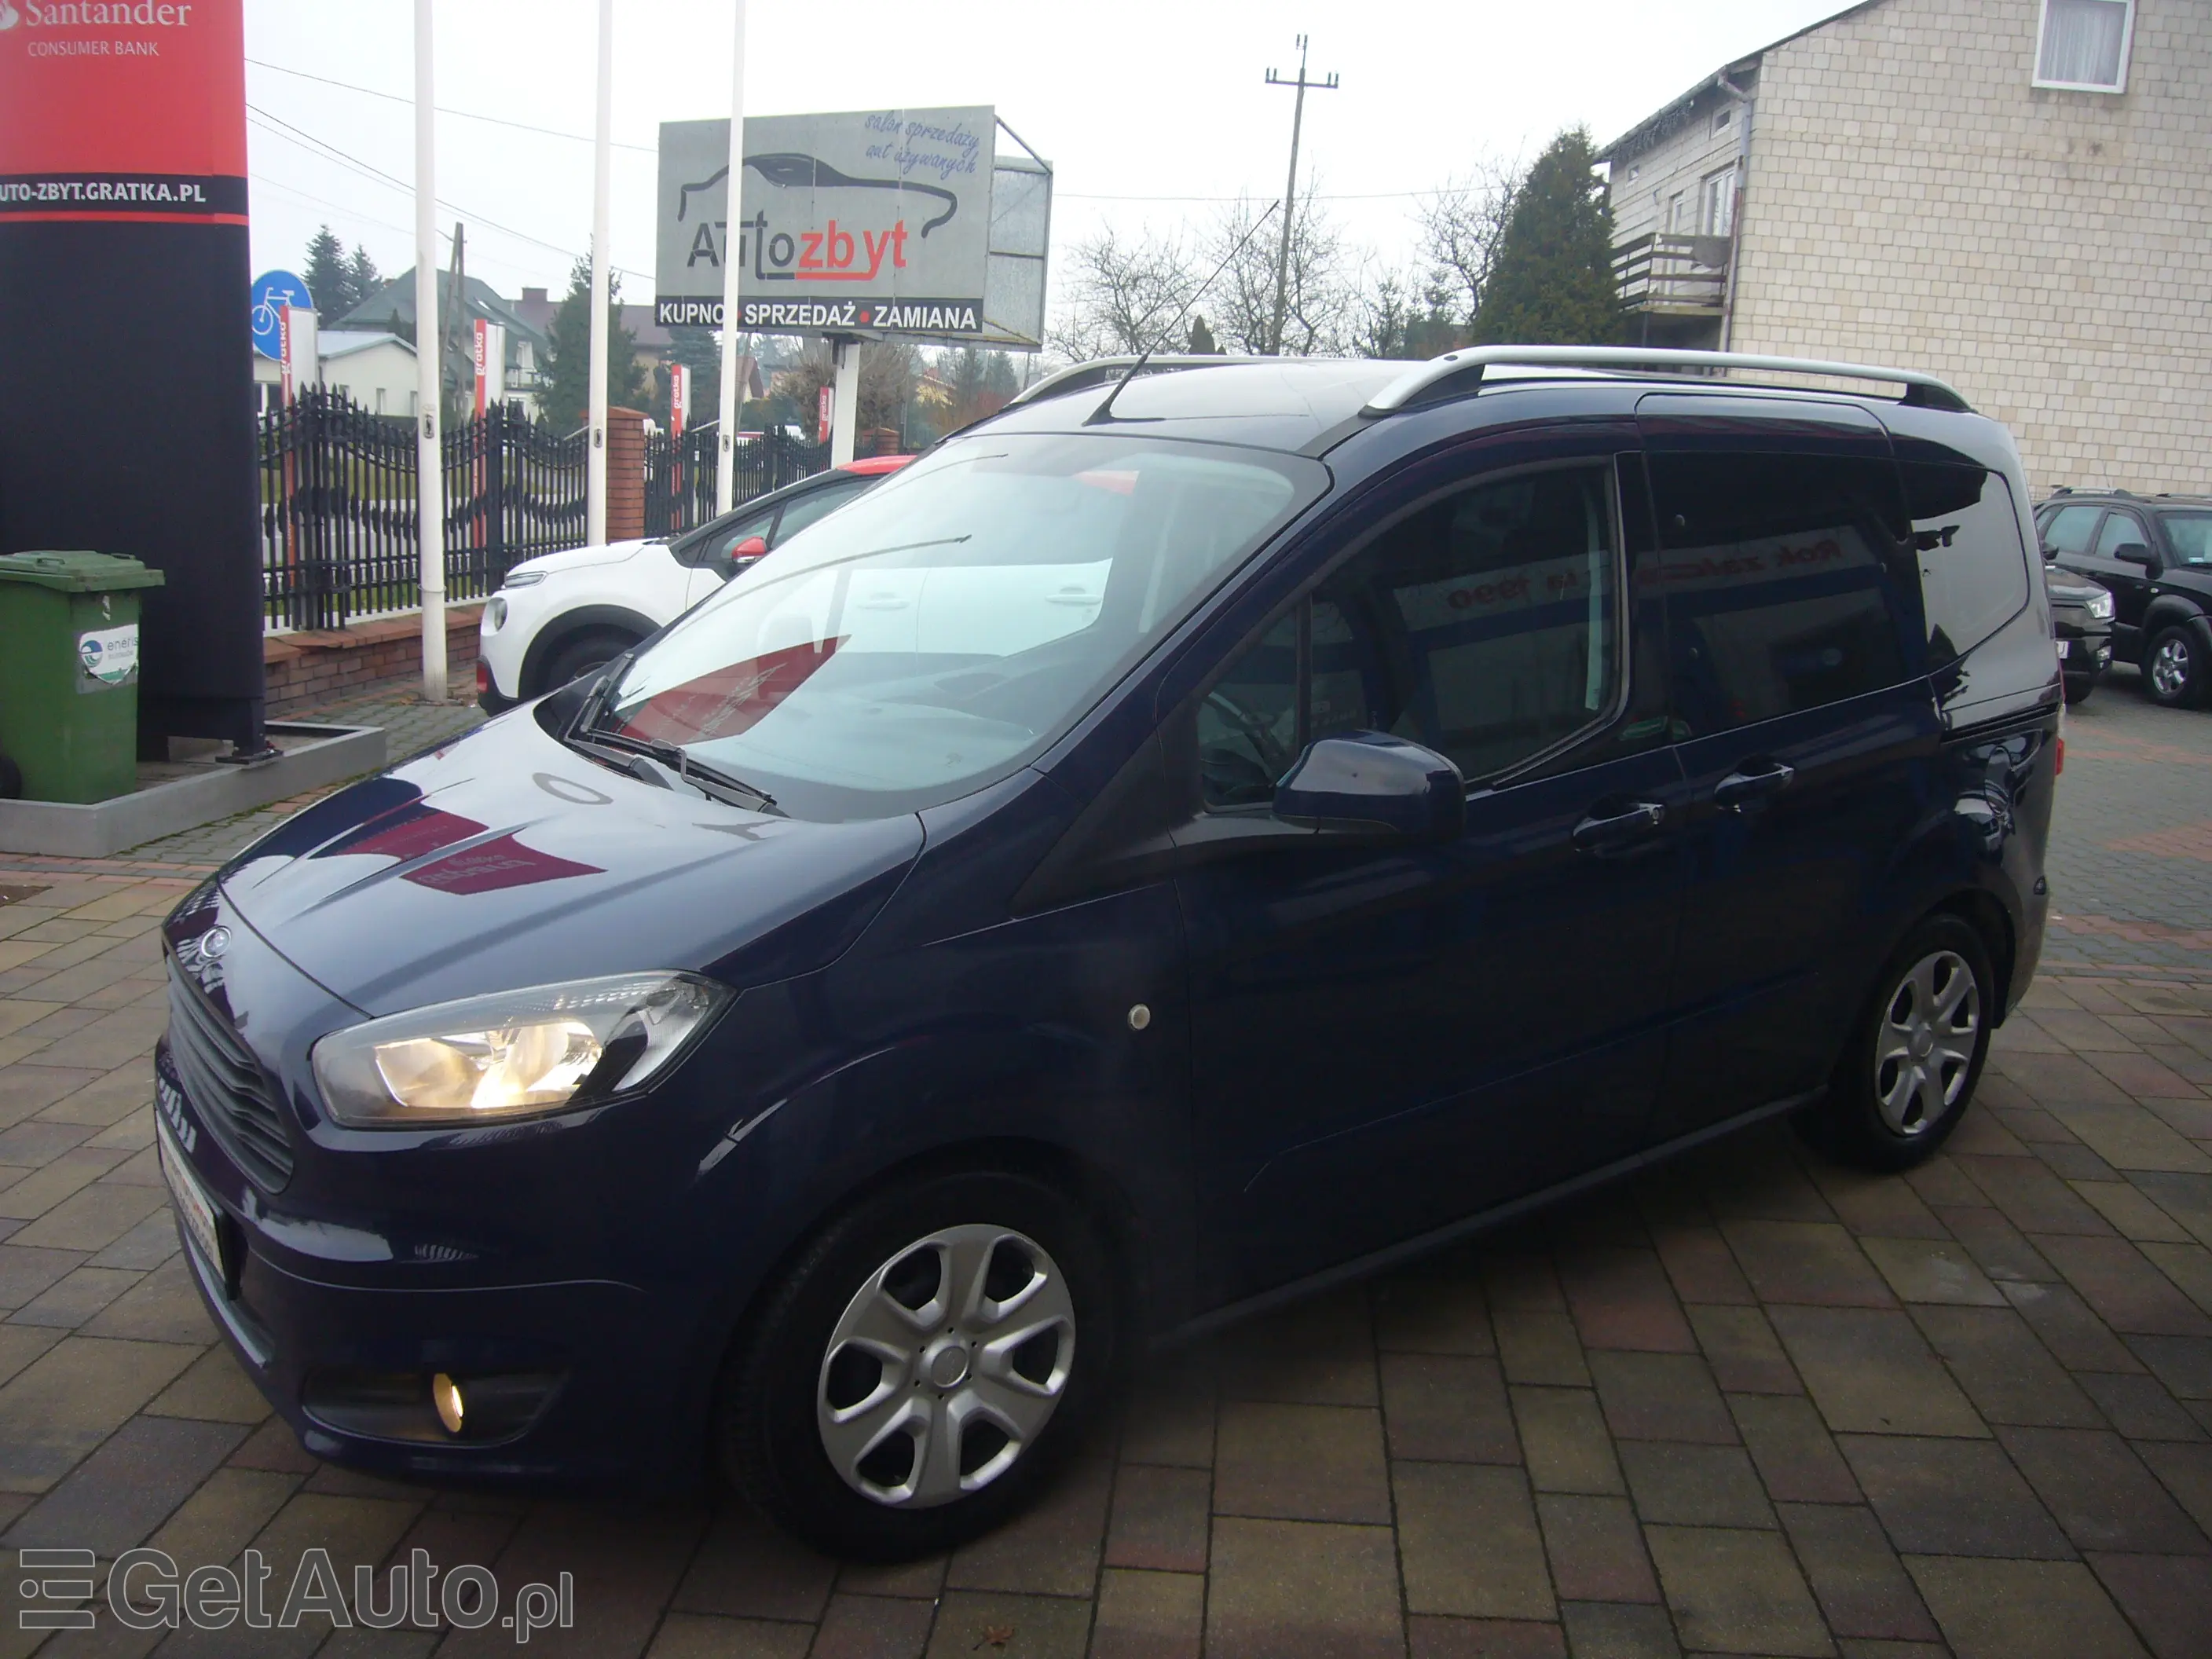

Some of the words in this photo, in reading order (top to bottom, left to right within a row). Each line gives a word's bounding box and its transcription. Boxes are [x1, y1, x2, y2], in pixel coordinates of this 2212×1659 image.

[25, 0, 192, 27] Santander
[27, 41, 110, 57] CONSUMER
[115, 41, 159, 57] BANK
[659, 302, 724, 325] KUPNO
[745, 302, 855, 327] SPRZEDAŻ
[873, 306, 977, 329] ZAMIANA
[474, 331, 485, 375] gratka
